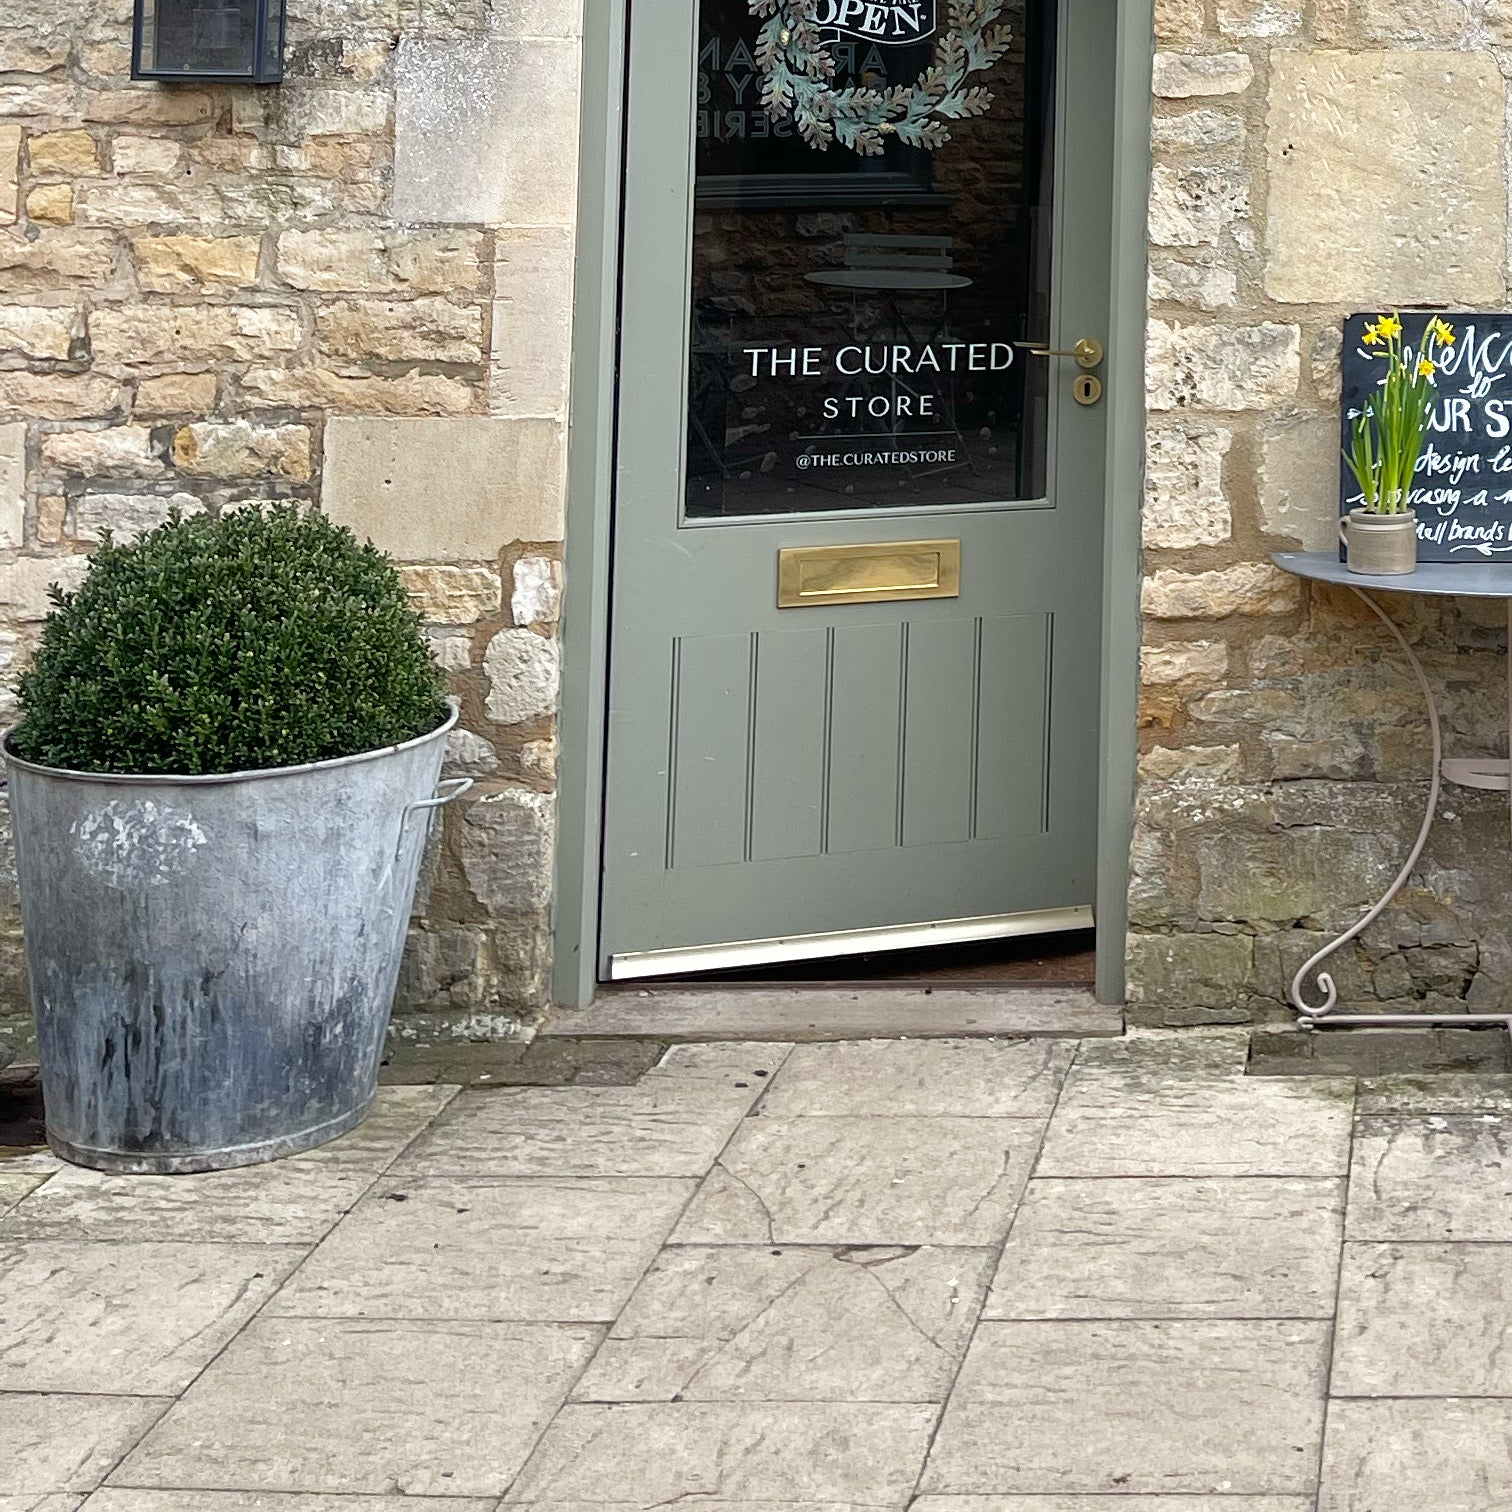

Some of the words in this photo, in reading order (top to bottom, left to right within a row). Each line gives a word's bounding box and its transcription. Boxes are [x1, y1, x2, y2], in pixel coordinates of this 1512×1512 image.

[743, 347, 822, 377] THE
[835, 343, 1015, 375] CURATED
[1459, 371, 1506, 398] to
[822, 395, 935, 419] STORE
[1419, 398, 1473, 433] UR
[796, 450, 956, 469] @THE.CURATEDSTORE
[1448, 519, 1505, 541] brands
